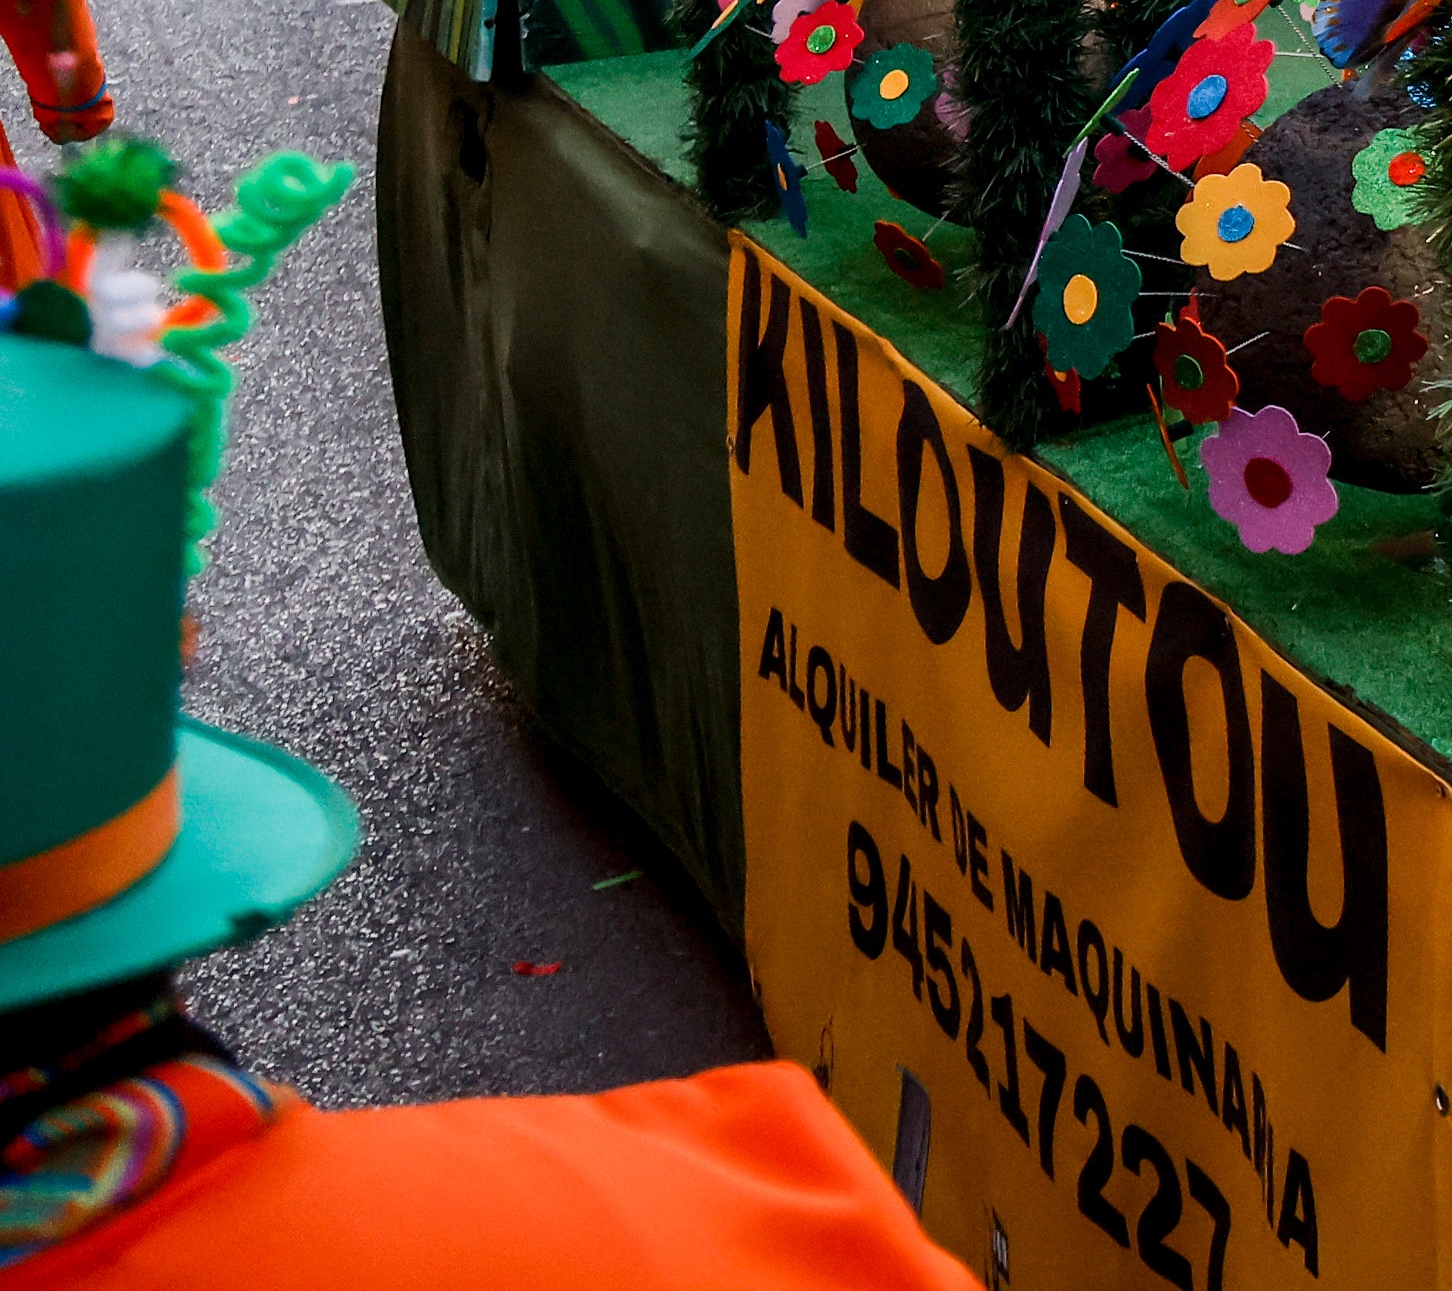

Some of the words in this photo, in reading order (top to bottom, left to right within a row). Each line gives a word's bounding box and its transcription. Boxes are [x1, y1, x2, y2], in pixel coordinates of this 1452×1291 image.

[736, 247, 1386, 1051] KILOUTOU
[758, 607, 942, 843] ALQUILER
[949, 784, 995, 913] DE
[847, 820, 1232, 1291] 945217227
